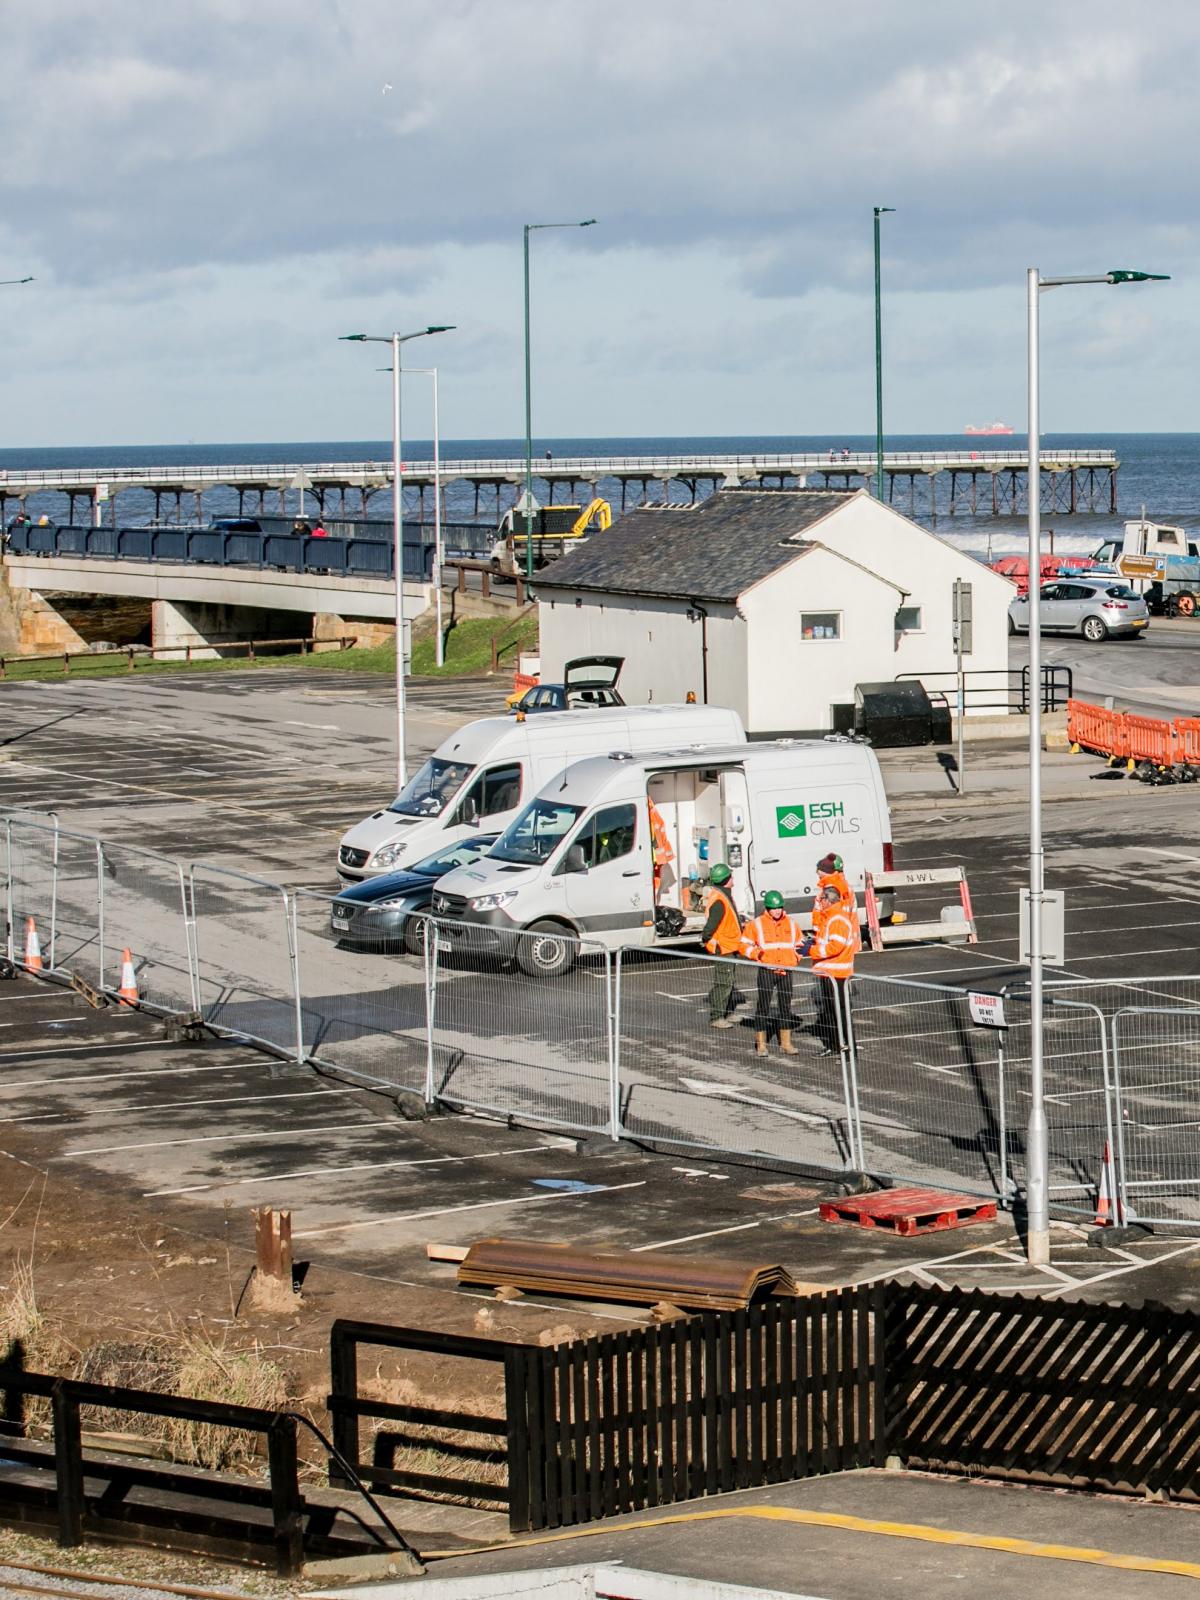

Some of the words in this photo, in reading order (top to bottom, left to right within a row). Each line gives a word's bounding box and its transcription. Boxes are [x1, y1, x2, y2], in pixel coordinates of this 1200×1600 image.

[809, 801, 844, 819] ESH
[809, 817, 860, 836] CIVILS
[974, 995, 997, 1006] DANGER
